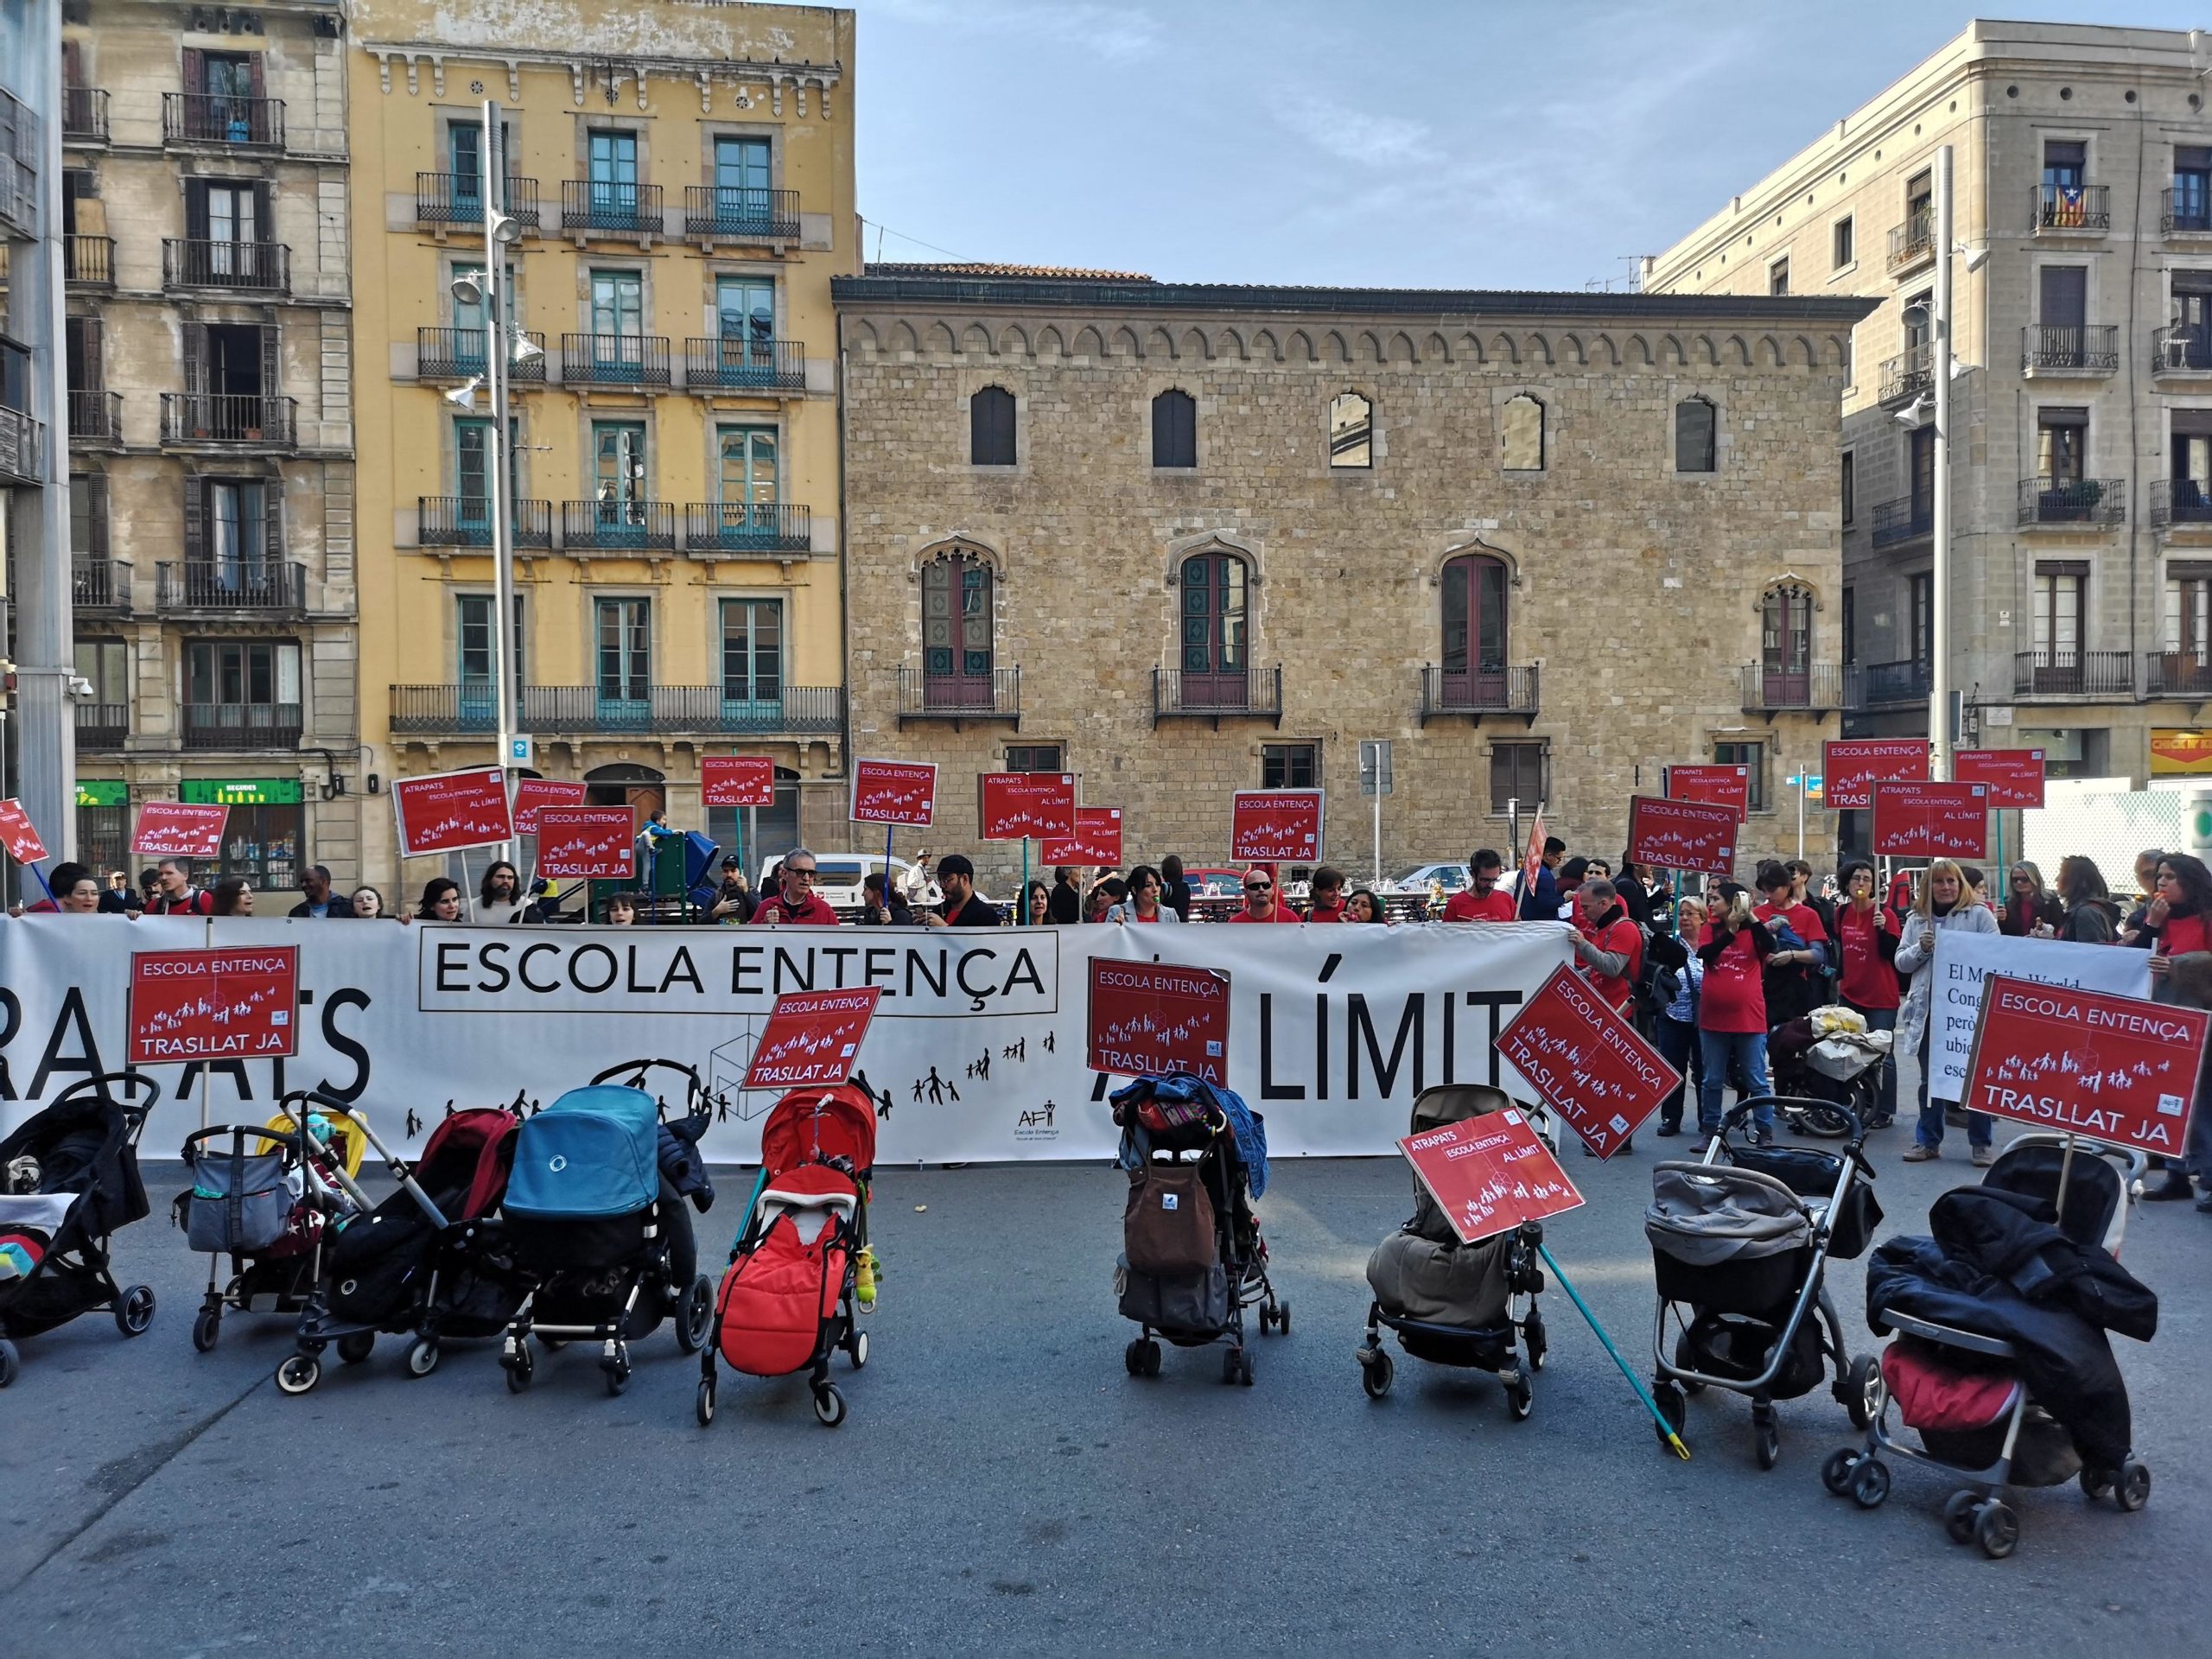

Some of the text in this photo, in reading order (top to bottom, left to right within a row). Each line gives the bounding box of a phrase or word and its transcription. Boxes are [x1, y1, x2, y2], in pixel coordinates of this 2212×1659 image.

[1831, 747, 1923, 757] ESCOLA ENTENÇA
[734, 761, 769, 770] ENTENÇA
[861, 767, 931, 780] ESCOLA ENTENÇA
[404, 782, 444, 793] ATRAPATS
[429, 788, 484, 801] ESCOLA ENTENÇA
[523, 785, 581, 796] ESCOLA ENTENÇA
[481, 796, 501, 807] LÍMIT
[707, 795, 769, 804] TRASLLAT JA
[1052, 796, 1071, 805] LÍMIT
[1238, 800, 1314, 810] ESCOLA ENTENÇA
[1930, 798, 1962, 807] ENTENÇA
[146, 806, 222, 818] ESCOLA ENTENÇA
[544, 813, 628, 824] ESCOLA ENTENÇA
[859, 808, 927, 822] TRASLLAT JA
[1642, 804, 1730, 823] ESCOLA ENTENÇA
[1957, 810, 1981, 820] LÍMIT
[138, 842, 213, 854] TRASLLAT JA
[1237, 847, 1312, 858] TRASLLAT JA
[544, 864, 628, 874] TRASLLAT JA
[1638, 851, 1726, 871] TRASLLAT JA
[143, 958, 286, 976] ESCOLA ENTENÇA
[1948, 963, 1963, 981] El
[436, 943, 1046, 1012] ESCOLA ENTENÇA
[1100, 971, 1220, 998] ESCOLA ENTENÇA
[779, 996, 869, 1014] ESCOLA ENTENÇA
[2000, 993, 2190, 1042] ESCOLA ENTENÇA
[1260, 953, 1523, 1101] LÍMIT
[1556, 979, 1662, 1090] ESCOLA ENTENÇA
[140, 1032, 283, 1055] TRASLLAT JA
[1098, 1049, 1218, 1080] TRASLLAT JA
[753, 1064, 842, 1083] TRASLLAT JA
[1509, 1035, 1609, 1149] TRASLLAT JA
[1983, 1084, 2171, 1146] TRASLLAT JA
[1411, 1130, 1458, 1152] ATRAPATS
[1446, 1134, 1510, 1159] ESCOLA ENTENÇA
[1503, 1143, 1541, 1163] AL LÍMIT
